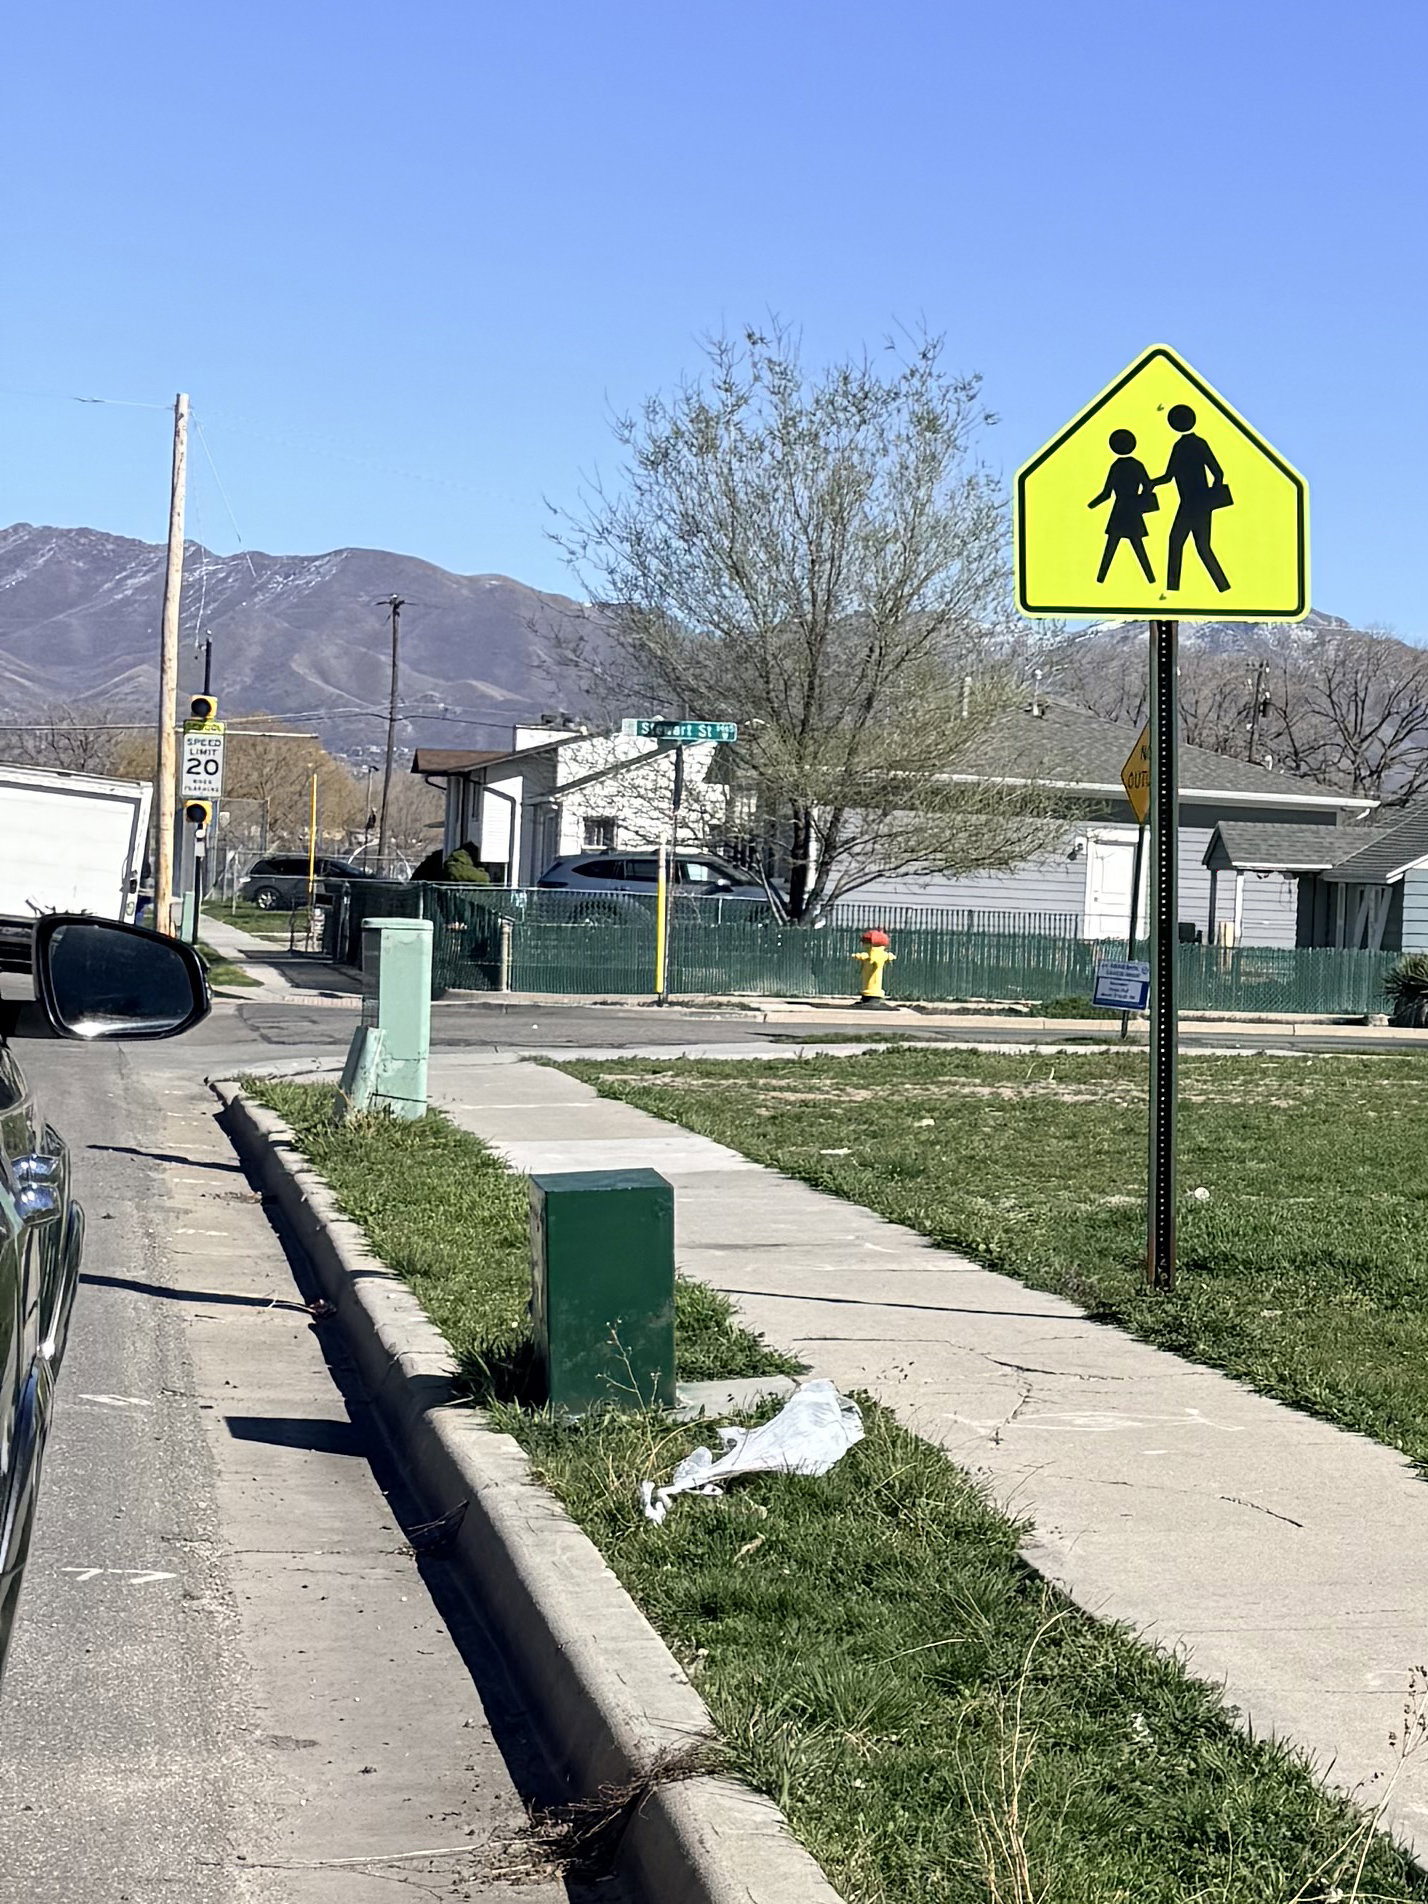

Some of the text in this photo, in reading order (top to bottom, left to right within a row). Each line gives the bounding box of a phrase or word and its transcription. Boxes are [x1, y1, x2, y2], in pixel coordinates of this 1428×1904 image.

[698, 724, 712, 738] St
[187, 738, 222, 747] SPEED
[189, 748, 219, 756] LIMIT
[186, 757, 219, 776] 20
